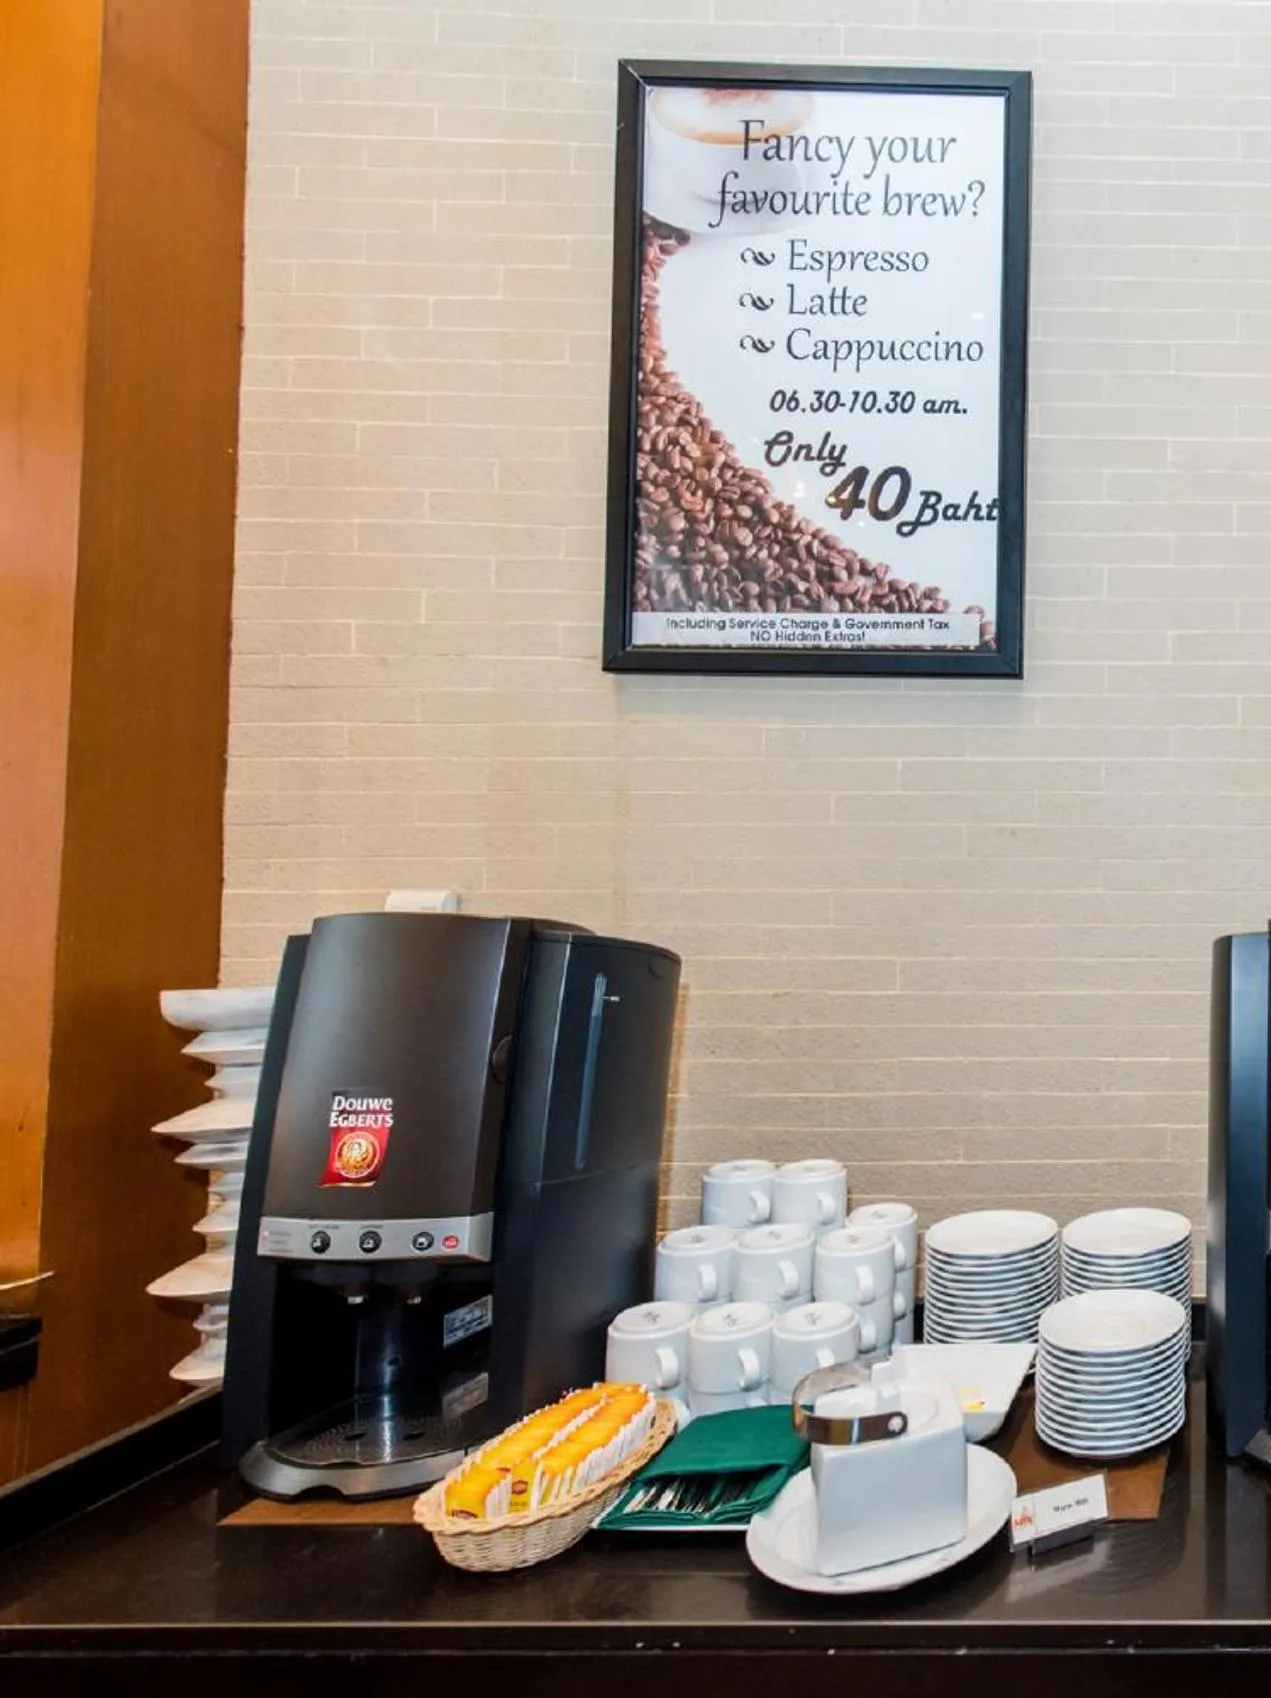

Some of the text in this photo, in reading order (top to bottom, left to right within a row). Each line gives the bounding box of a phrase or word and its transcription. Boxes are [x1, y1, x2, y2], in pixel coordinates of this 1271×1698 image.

[740, 119, 957, 178] Fancy your
[708, 171, 985, 228] favourite brew?
[788, 239, 929, 282] Espresso
[786, 284, 868, 317] Latte
[786, 328, 984, 373] Cappuccino
[770, 390, 967, 414] 06.30-10.30 am.
[764, 430, 847, 476] Only
[825, 466, 999, 538] 40 Baht
[666, 618, 949, 631] Including Service Charge & Government Tax
[750, 630, 865, 642] NO Hidden Extras!
[329, 1111, 394, 1129] EGBERTS
[332, 1095, 394, 1111] Douwe
